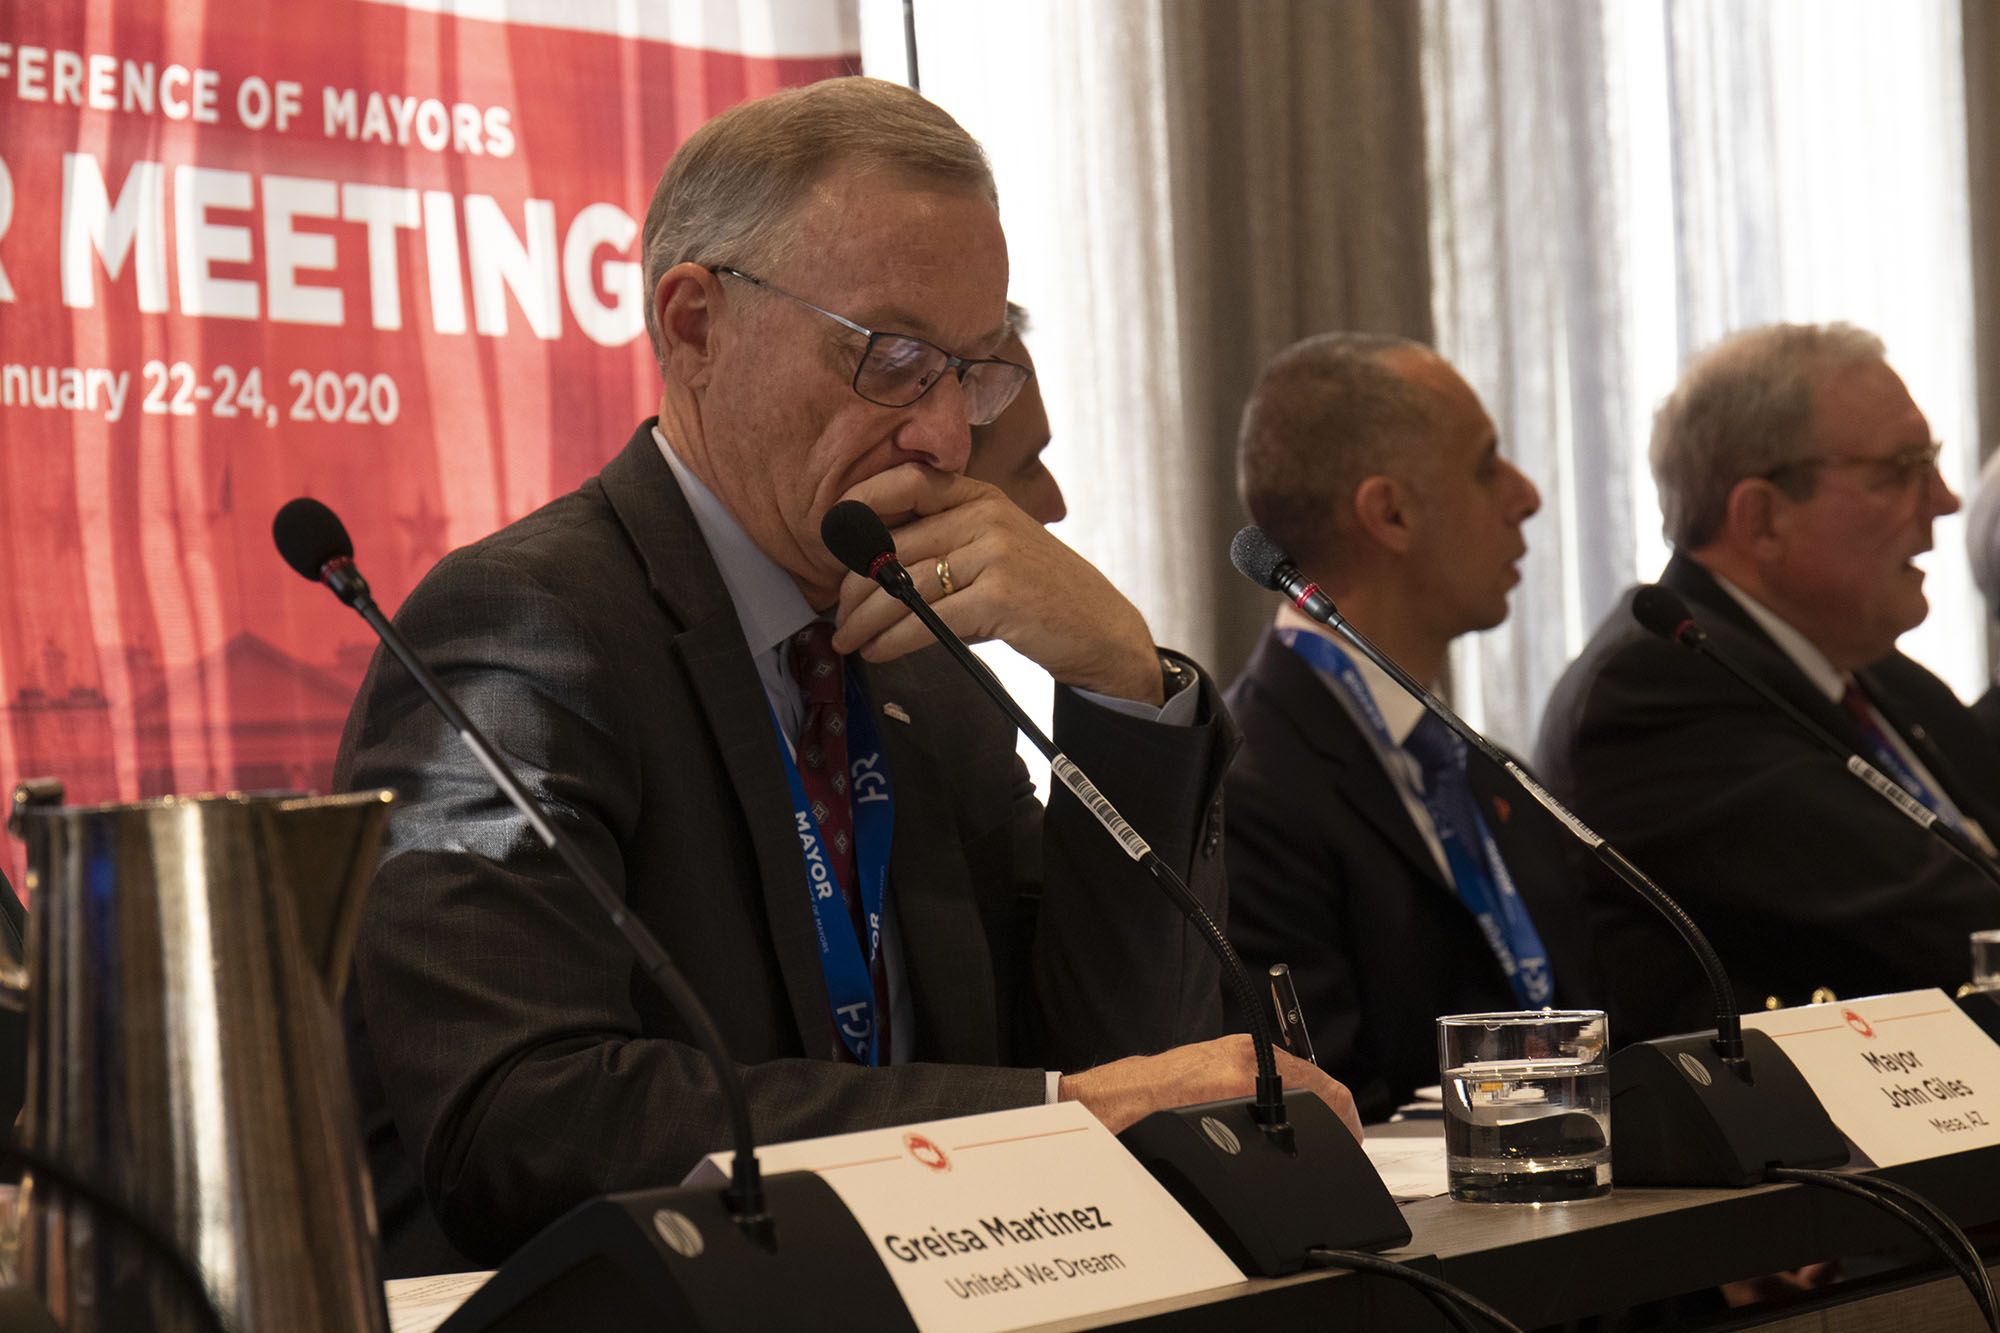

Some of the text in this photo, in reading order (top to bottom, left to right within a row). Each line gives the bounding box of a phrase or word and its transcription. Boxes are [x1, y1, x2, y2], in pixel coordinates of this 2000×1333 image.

[236, 77, 302, 131] OF
[322, 86, 516, 157] MAYORS
[61, 151, 645, 348] MEETING
[142, 359, 278, 428] 22-24,
[288, 370, 399, 424] 2020
[795, 811, 833, 900] MAYOR
[1860, 1050, 1923, 1075] Mayor
[1881, 1077, 1974, 1109] John Giles
[1928, 1110, 1990, 1134] Mesa, AZ
[884, 1206, 1112, 1263] Greisa Martinez
[944, 1252, 1127, 1299] United We Dream
